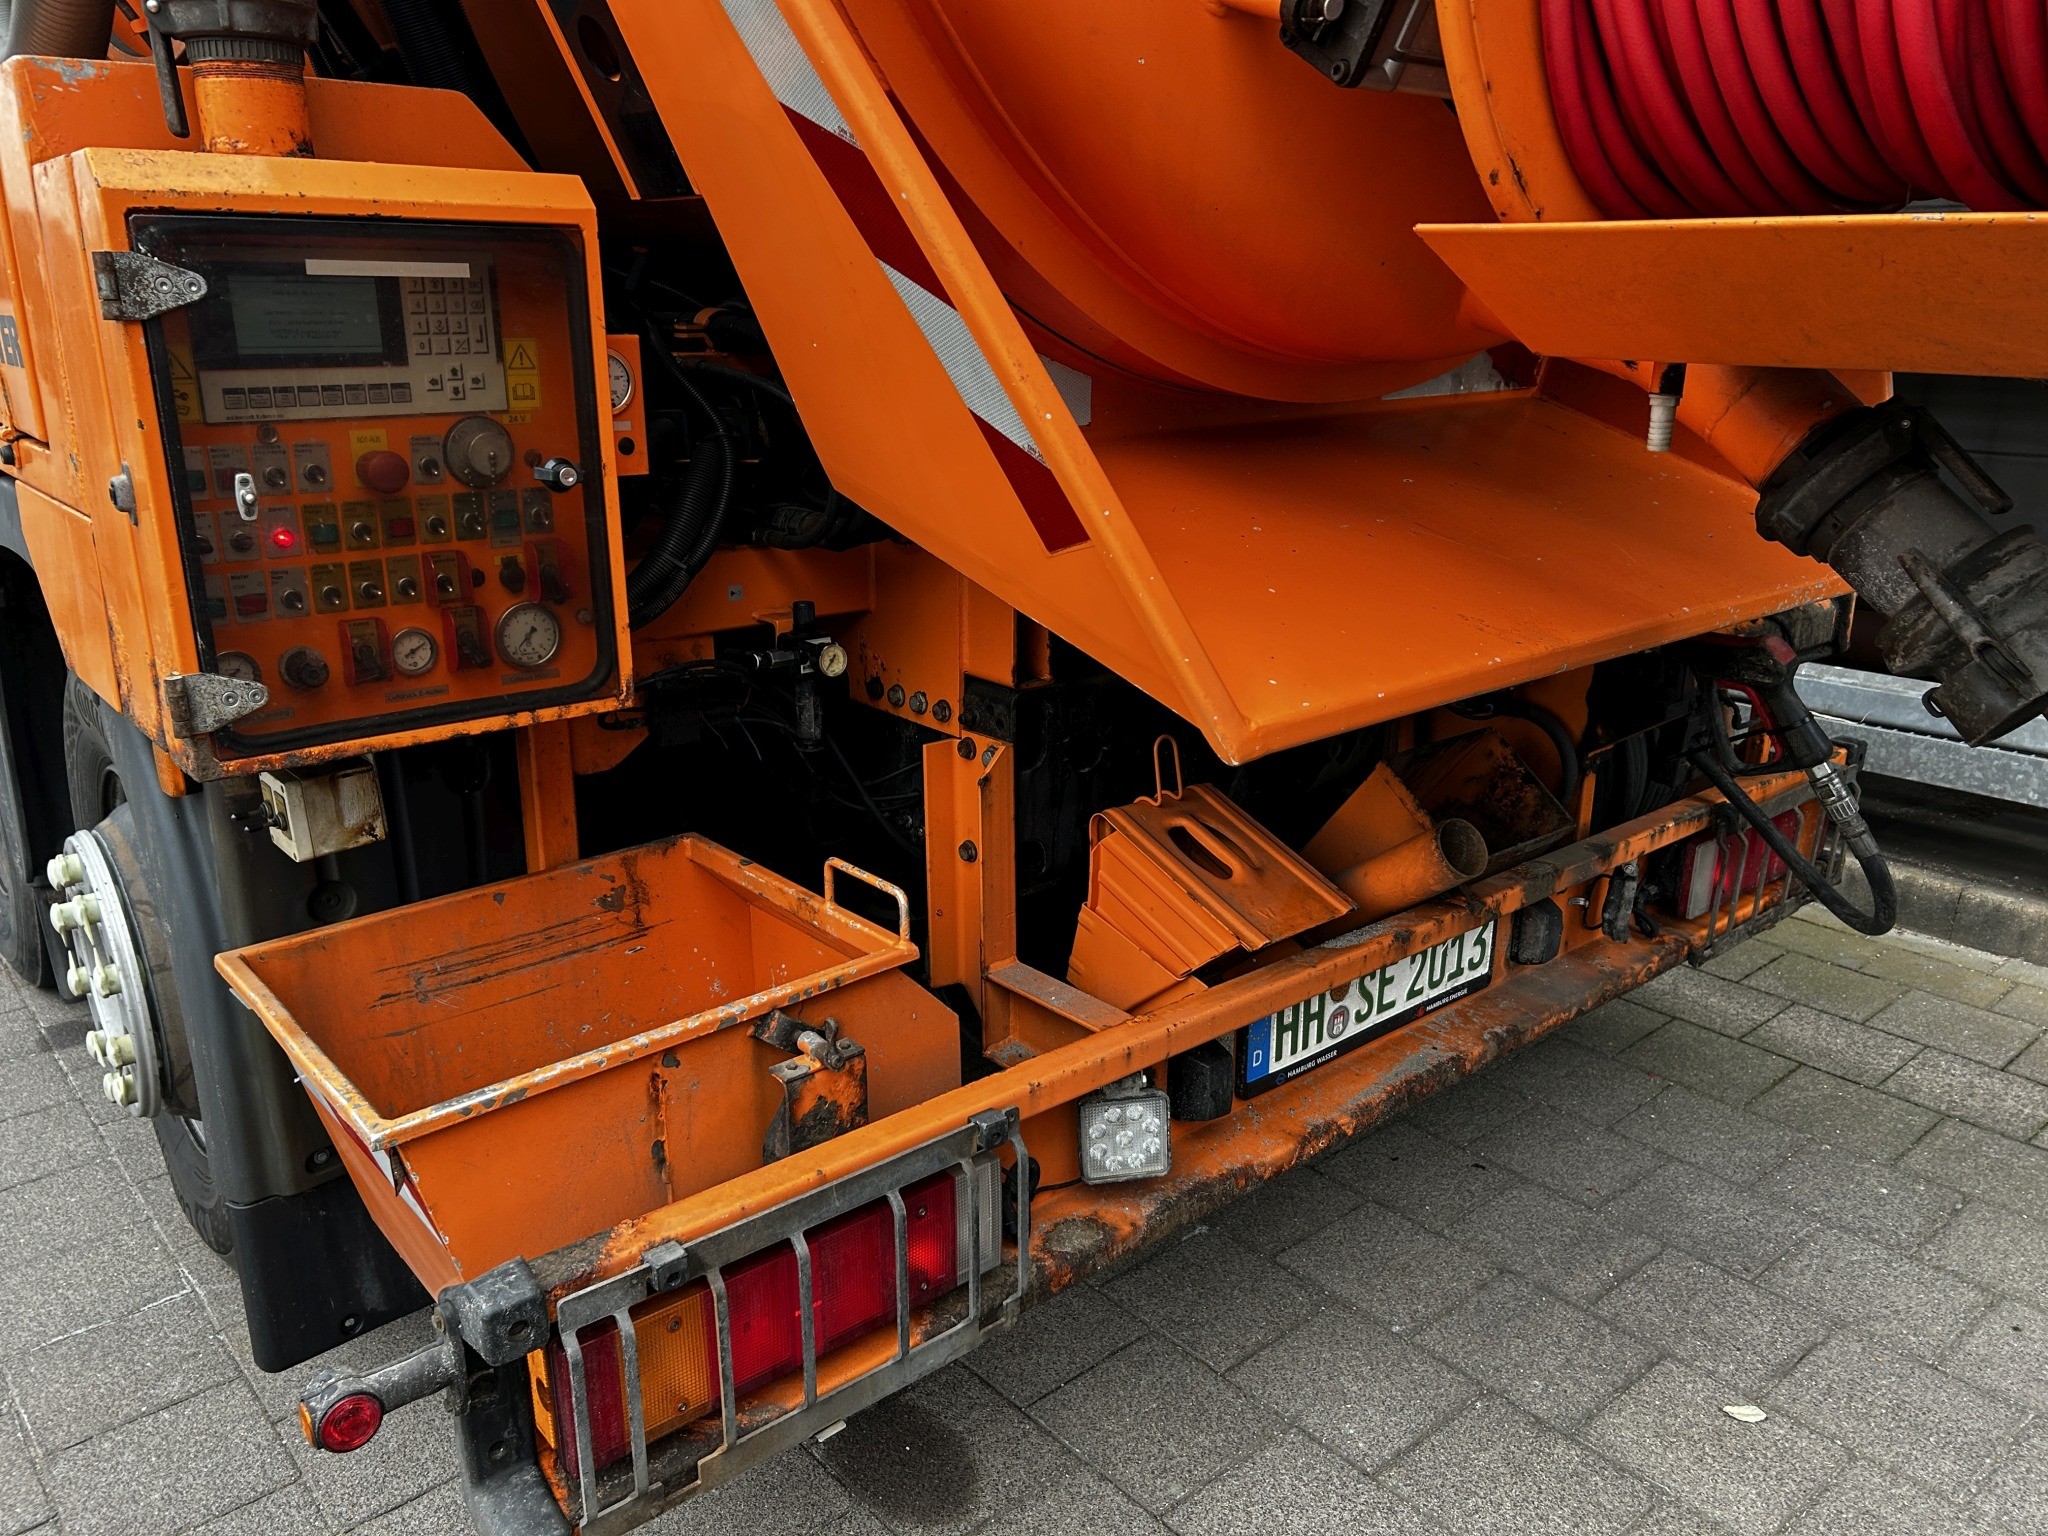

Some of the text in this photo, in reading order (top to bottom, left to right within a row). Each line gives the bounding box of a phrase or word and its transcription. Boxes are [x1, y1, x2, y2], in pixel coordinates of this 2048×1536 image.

[509, 415, 518, 423] 24
[1275, 923, 1488, 1062] HH SE 2013
[1425, 988, 1468, 1011] HAMBURG ENERGIE
[1252, 1049, 1263, 1067] D
[1287, 1049, 1338, 1078] HAMBURG WASSER
